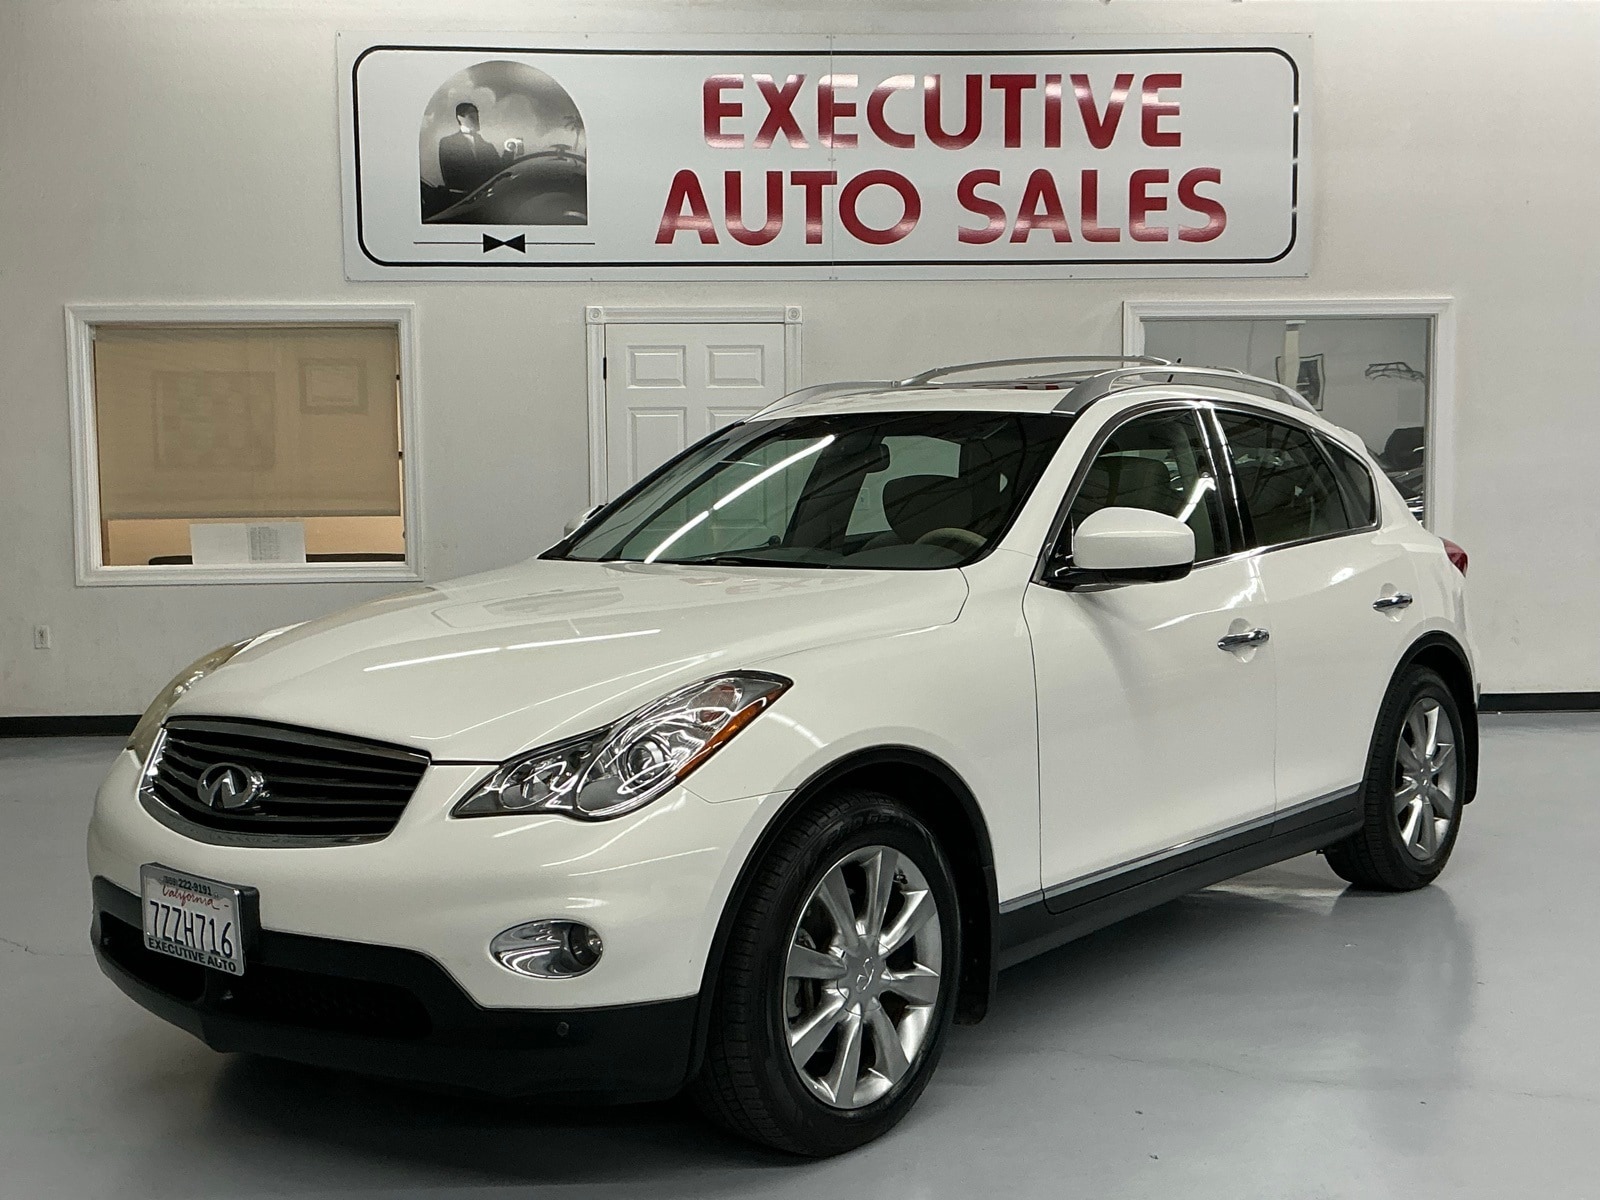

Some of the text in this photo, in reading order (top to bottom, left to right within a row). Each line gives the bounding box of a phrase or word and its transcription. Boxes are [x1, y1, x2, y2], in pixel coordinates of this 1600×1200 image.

[702, 73, 1182, 150] EXECUTIVE
[654, 167, 1227, 246] AUTO SALES
[162, 885, 220, 910] California
[149, 938, 236, 973] EXECUTIVE AUTO
[150, 900, 233, 958] 7ZZH716
